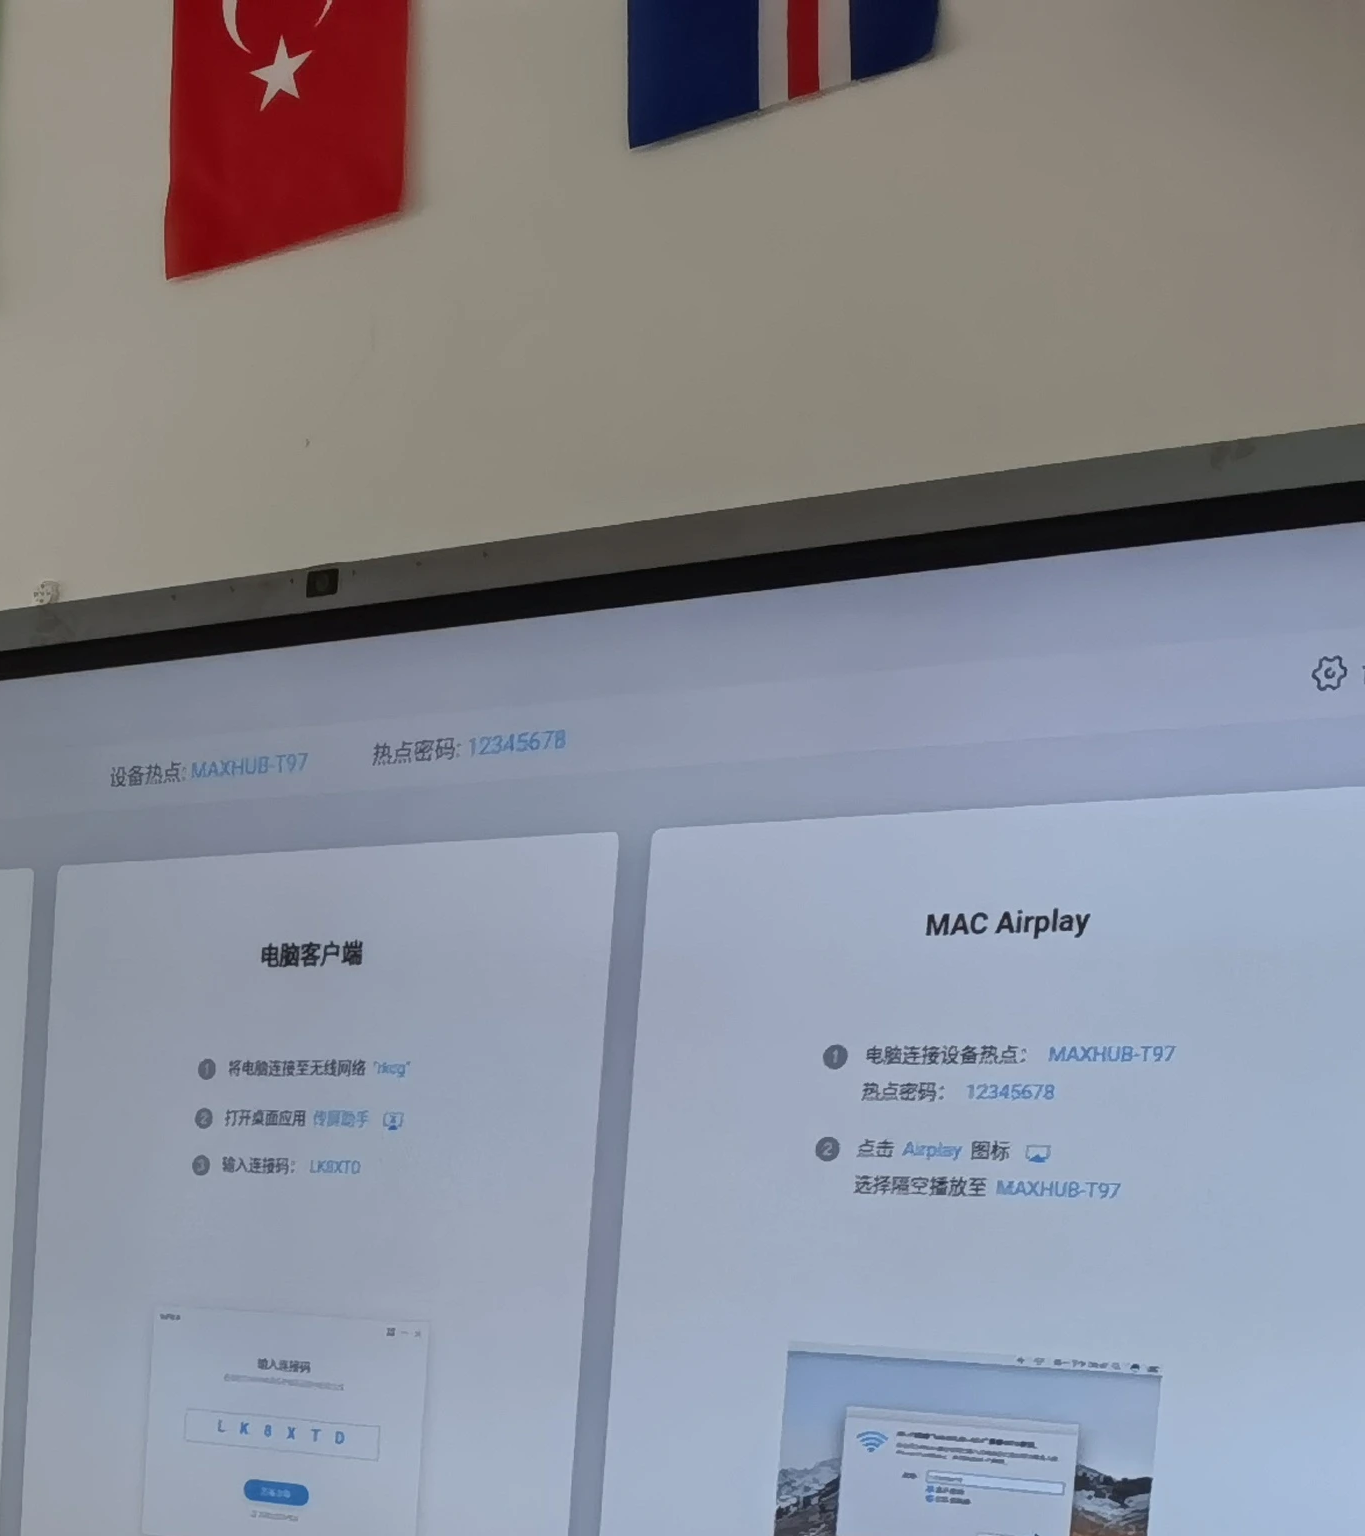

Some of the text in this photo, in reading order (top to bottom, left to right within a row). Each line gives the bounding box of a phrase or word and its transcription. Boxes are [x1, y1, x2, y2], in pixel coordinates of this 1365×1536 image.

[469, 729, 566, 757] 12345678
[191, 752, 309, 779] MAXHUB-T97
[925, 908, 1091, 939] MAC Airplay
[260, 939, 364, 968] 电脑客户端
[1048, 1045, 1176, 1063] MAXHUB-T97
[967, 1083, 1056, 1101] 12345678
[971, 1141, 1010, 1161] 图标
[996, 1179, 1121, 1199] MAXHUB-T97
